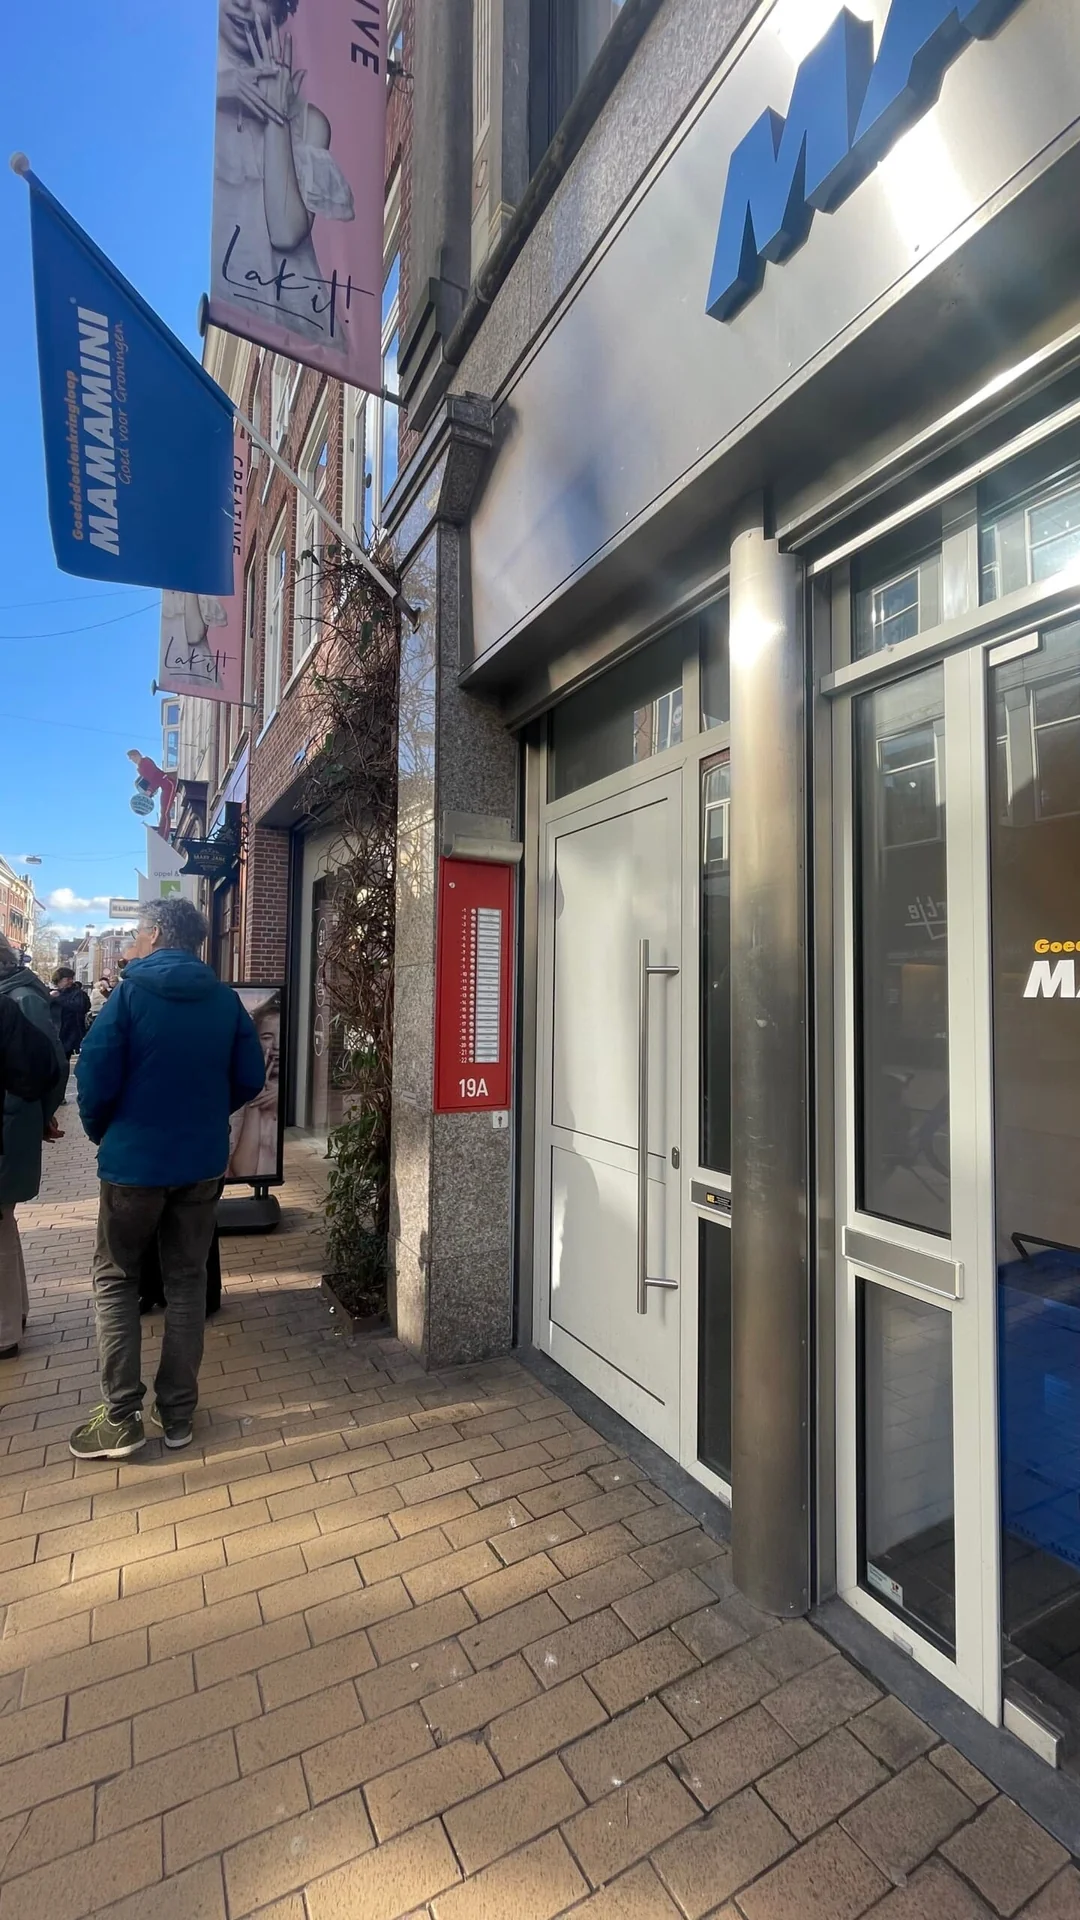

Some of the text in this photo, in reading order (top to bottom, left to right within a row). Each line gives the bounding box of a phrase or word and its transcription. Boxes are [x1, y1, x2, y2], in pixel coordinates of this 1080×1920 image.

[77, 306, 120, 556] MAMAMINI
[118, 407, 129, 442] voor
[116, 447, 131, 485] Goed
[1023, 959, 1080, 998] M
[458, 1077, 489, 1098] 19A
